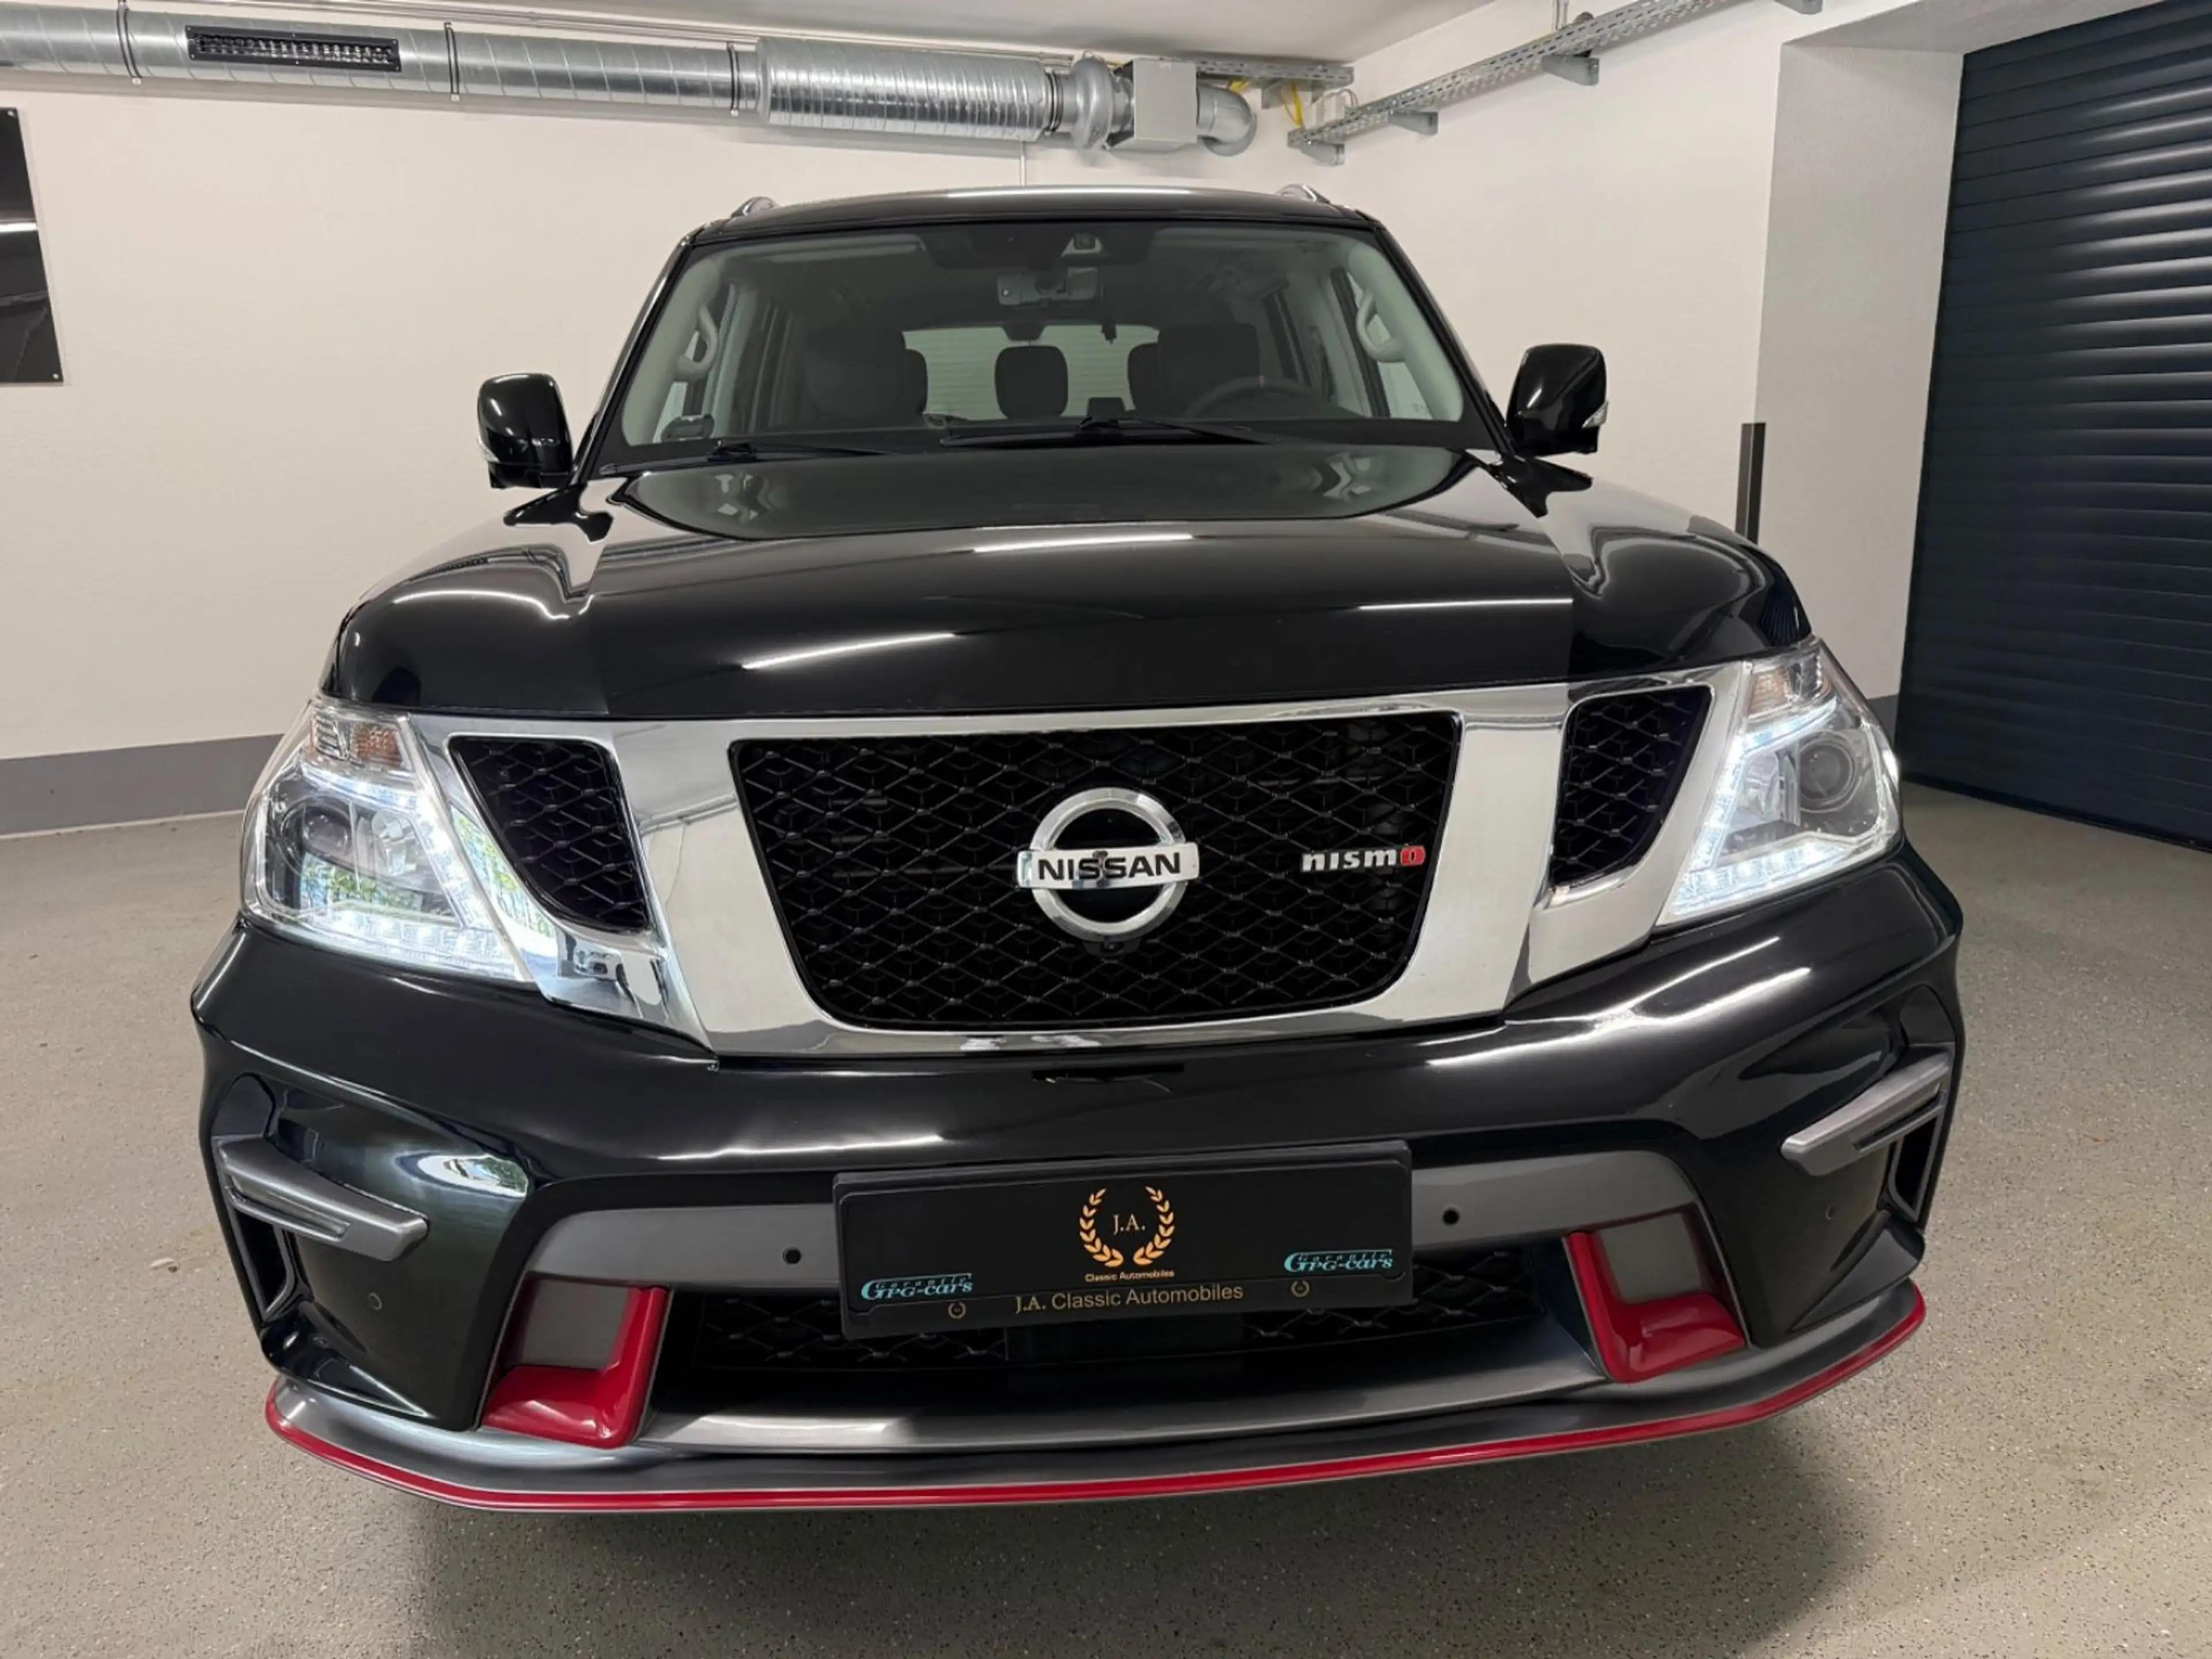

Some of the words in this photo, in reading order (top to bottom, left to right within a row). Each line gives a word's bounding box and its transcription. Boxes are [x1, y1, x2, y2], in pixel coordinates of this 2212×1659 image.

[1039, 852, 1181, 880] NISSAN
[1302, 846, 1426, 871] nismo
[1113, 1214, 1146, 1236] J.A.
[1085, 1273, 1118, 1282] Classic
[1120, 1270, 1175, 1280] Automobiles
[1015, 1296, 1046, 1314] J.A.
[1051, 1291, 1122, 1310] Classic
[1126, 1283, 1244, 1305] Automobiles
